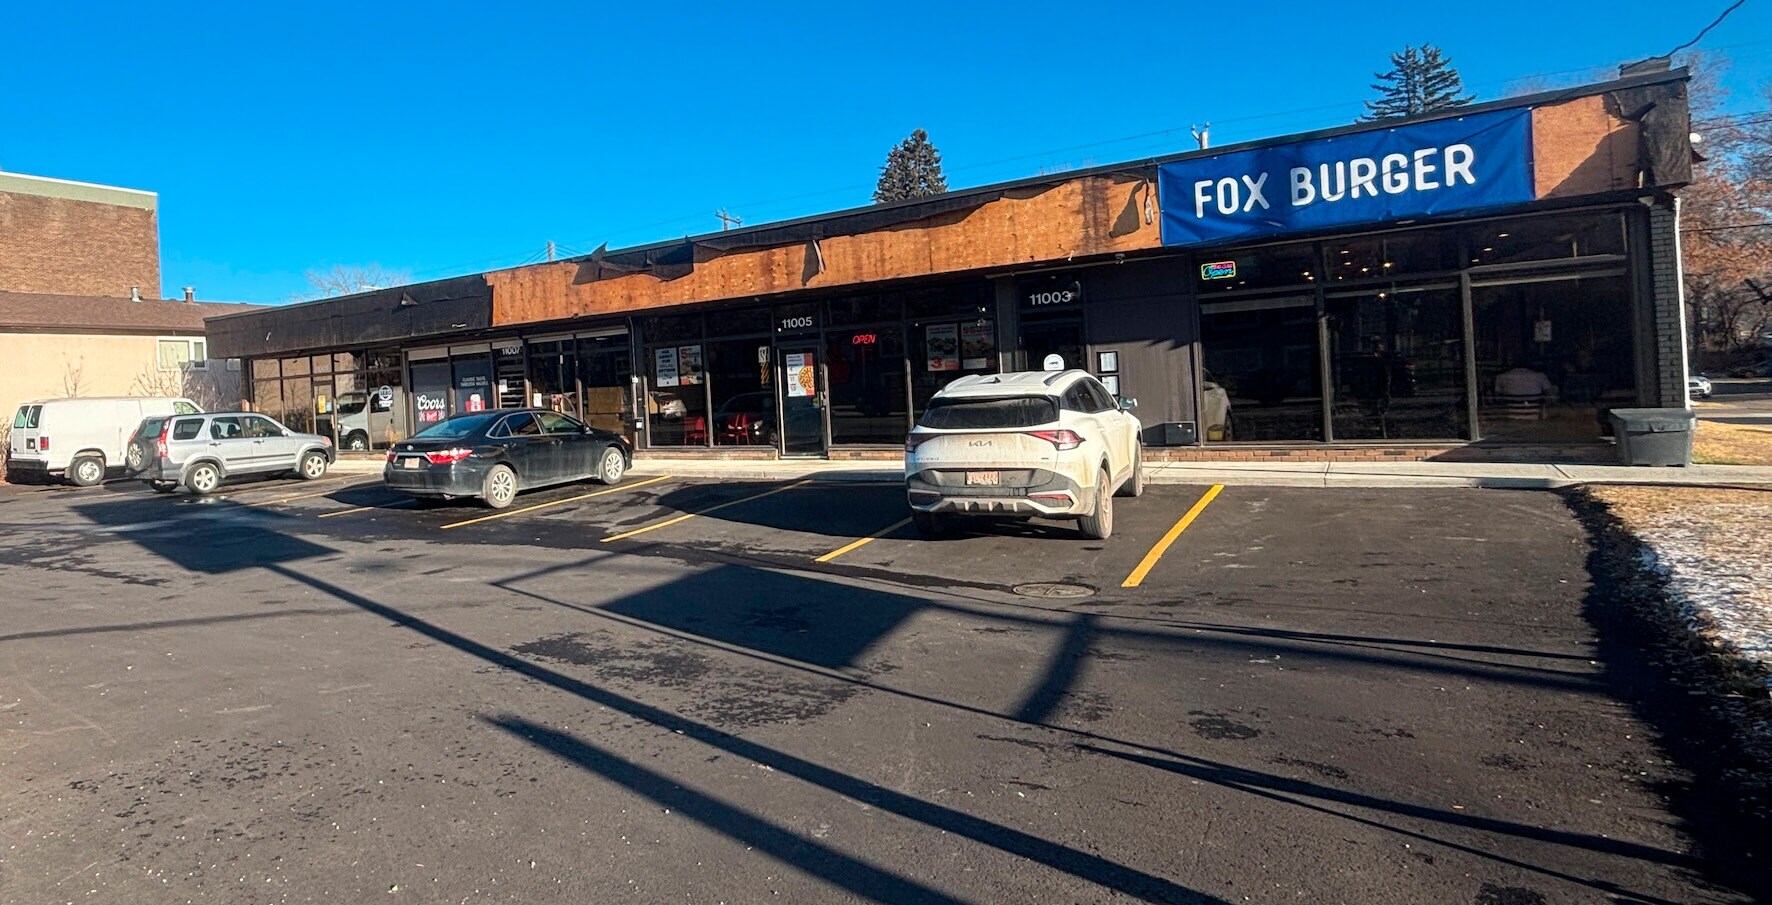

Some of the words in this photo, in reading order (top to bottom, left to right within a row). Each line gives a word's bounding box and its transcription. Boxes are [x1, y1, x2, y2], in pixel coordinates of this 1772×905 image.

[1194, 172, 1270, 218] FOX
[1290, 144, 1476, 206] BURGER
[1203, 265, 1234, 279] Open
[1029, 291, 1071, 305] 11003
[782, 317, 812, 329] 11005
[852, 334, 876, 344] OPEN
[502, 344, 520, 355] 11007
[417, 394, 445, 410] Coors
